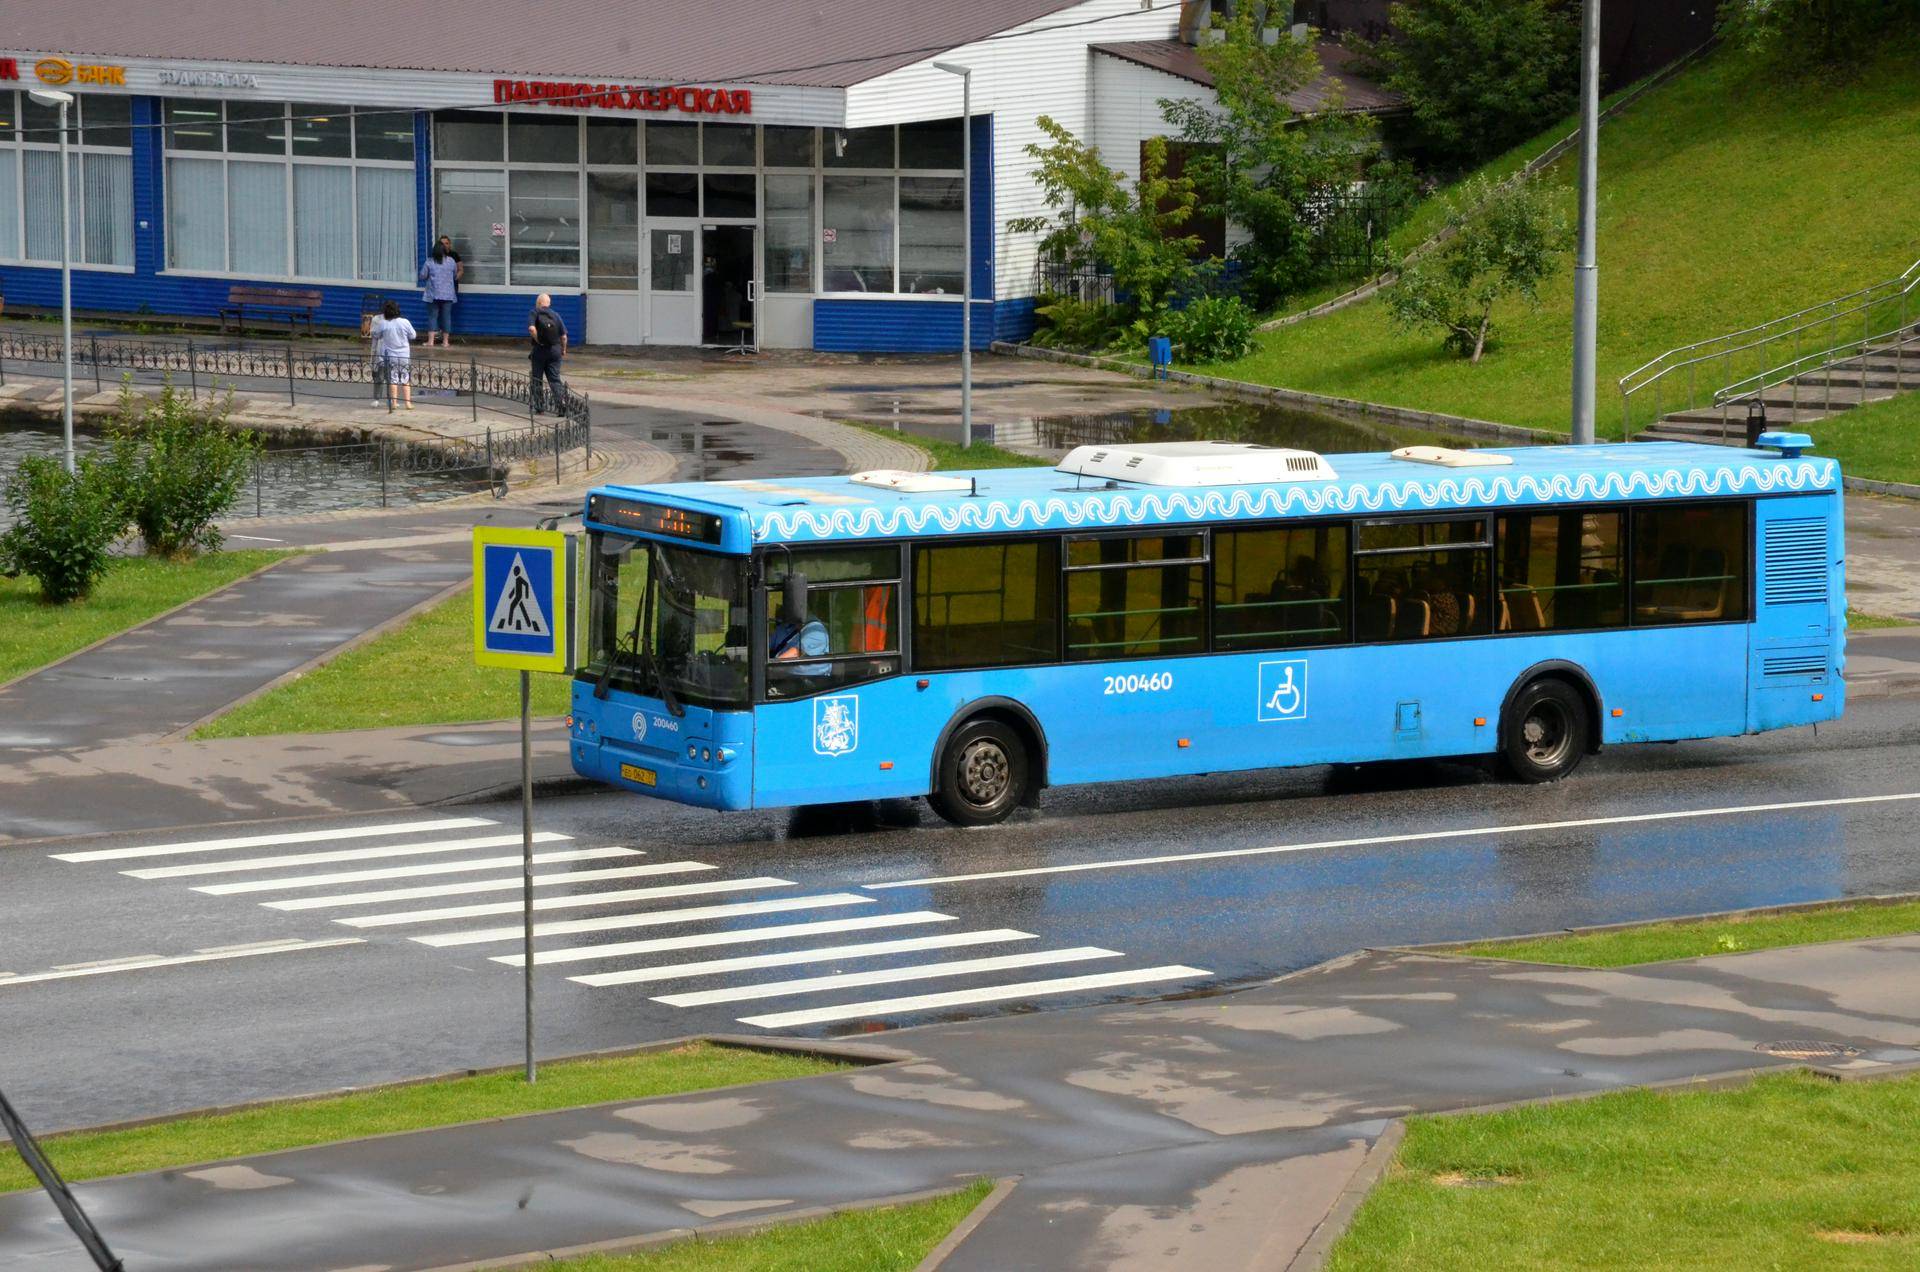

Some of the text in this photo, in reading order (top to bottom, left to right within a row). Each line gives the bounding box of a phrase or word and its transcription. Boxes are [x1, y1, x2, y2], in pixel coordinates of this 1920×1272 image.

[77, 64, 127, 85] БАНК
[493, 79, 752, 114] ПАРИКМАХЕРСКАЯ
[1103, 672, 1173, 695] 200460
[653, 717, 678, 732] 200460
